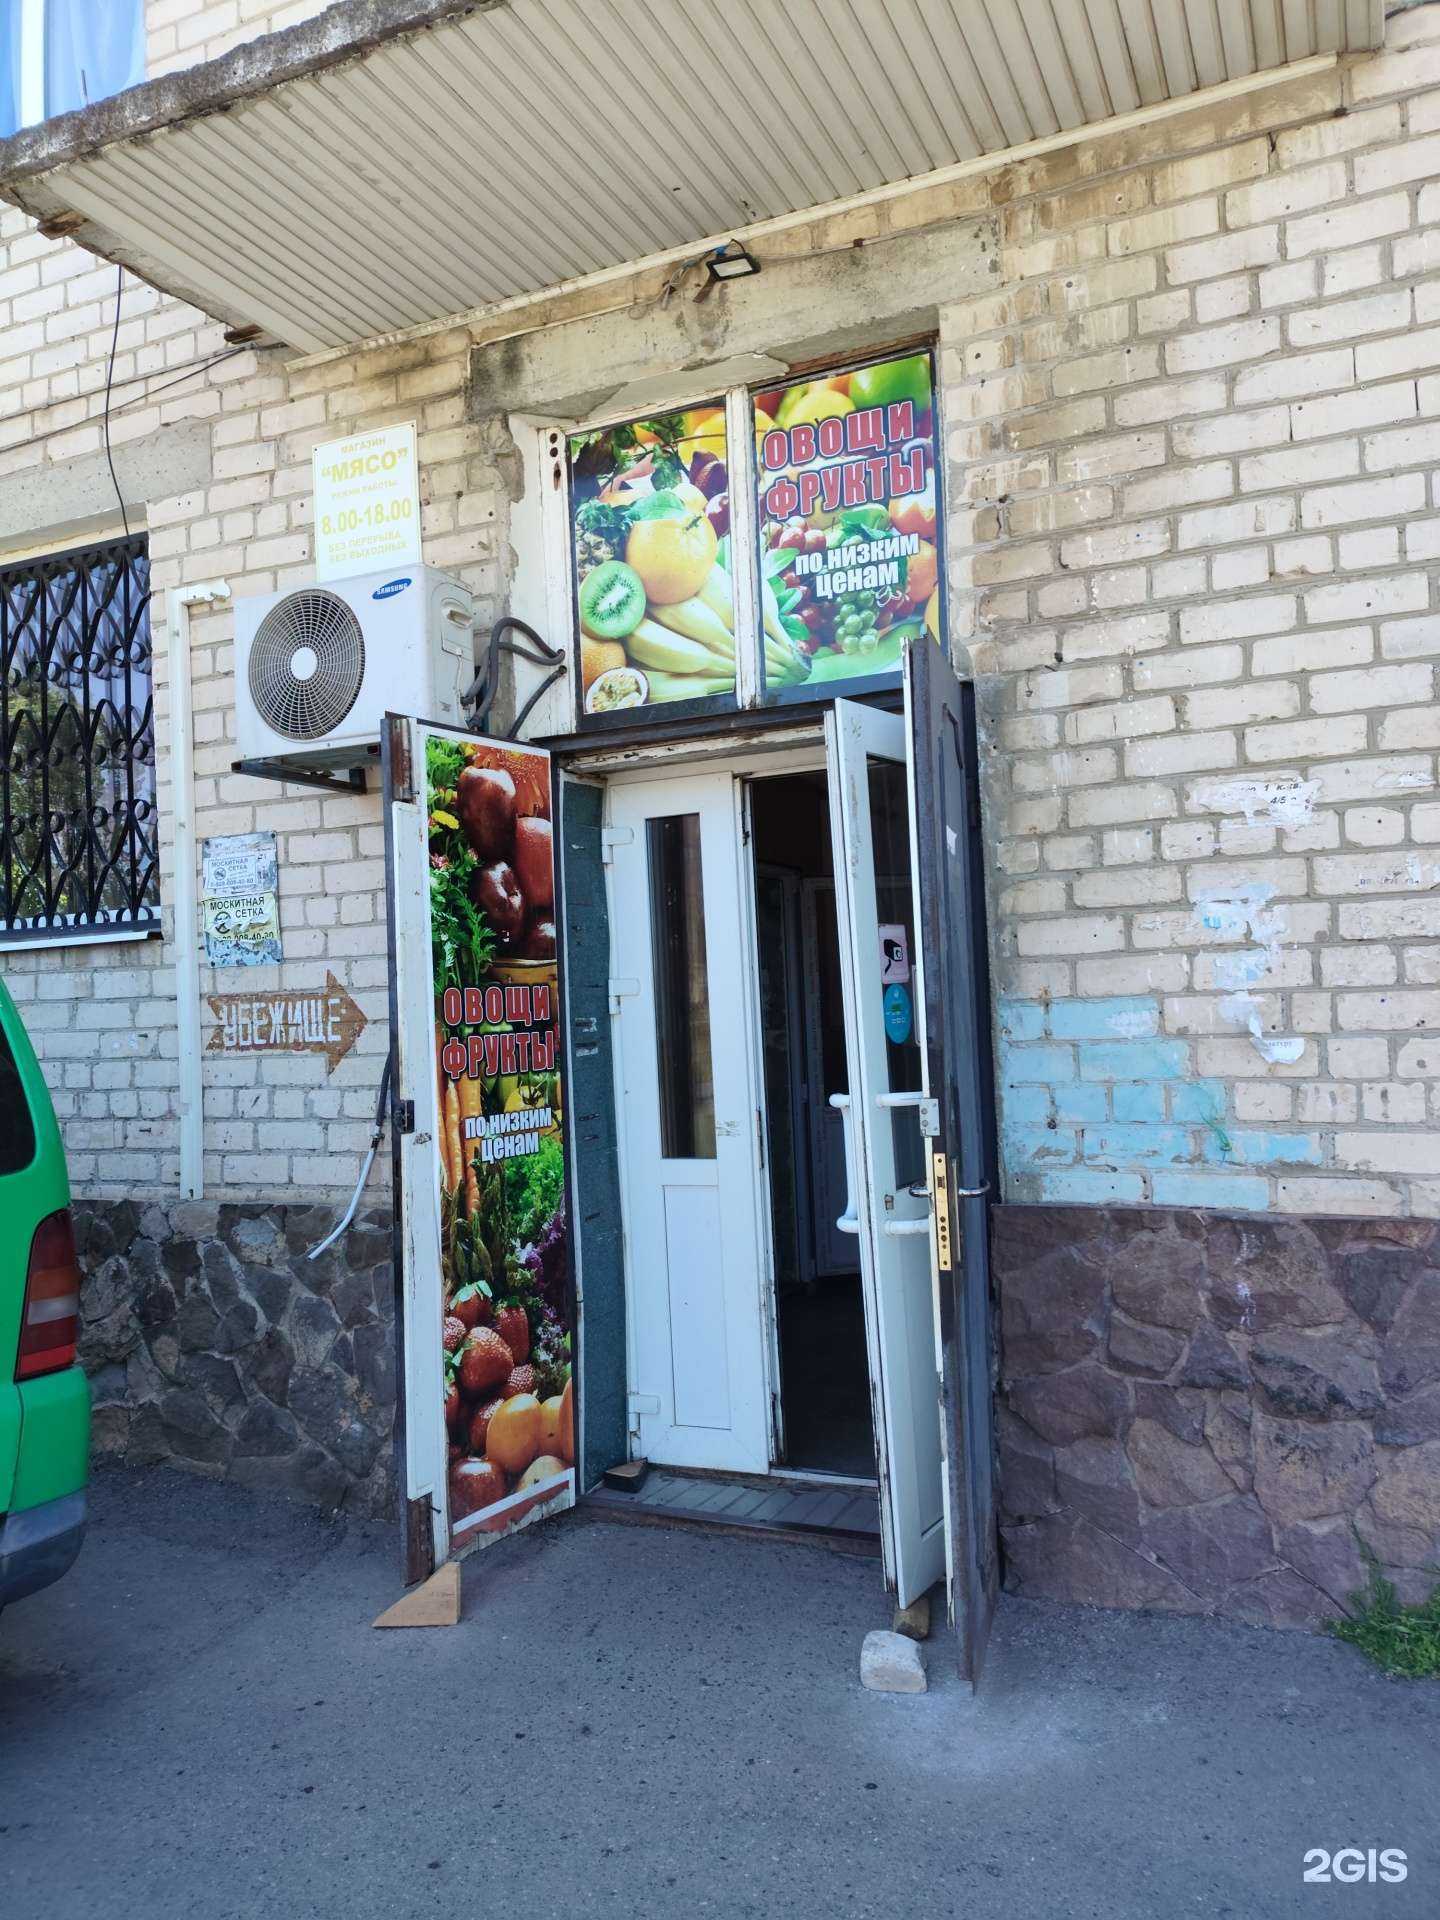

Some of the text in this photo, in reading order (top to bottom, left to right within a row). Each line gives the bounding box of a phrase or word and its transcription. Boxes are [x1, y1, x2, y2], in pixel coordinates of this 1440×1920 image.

[341, 437, 386, 454] МАГАЗИН
[763, 400, 914, 470] ОВОЩИ
[766, 449, 926, 520] ФРУКТЫ
[321, 497, 412, 535] 8.00-18.00
[795, 552, 823, 576] по
[376, 583, 408, 595] SAMSUNG
[816, 560, 899, 600] ценам
[210, 896, 265, 911] МОСКИТНАЯ
[235, 907, 264, 919] СЕТКА
[443, 985, 550, 1027] ОВОЩИ
[442, 1031, 555, 1080] ФРУКТЫ
[464, 1117, 488, 1139] по
[481, 1131, 540, 1162] ценам
